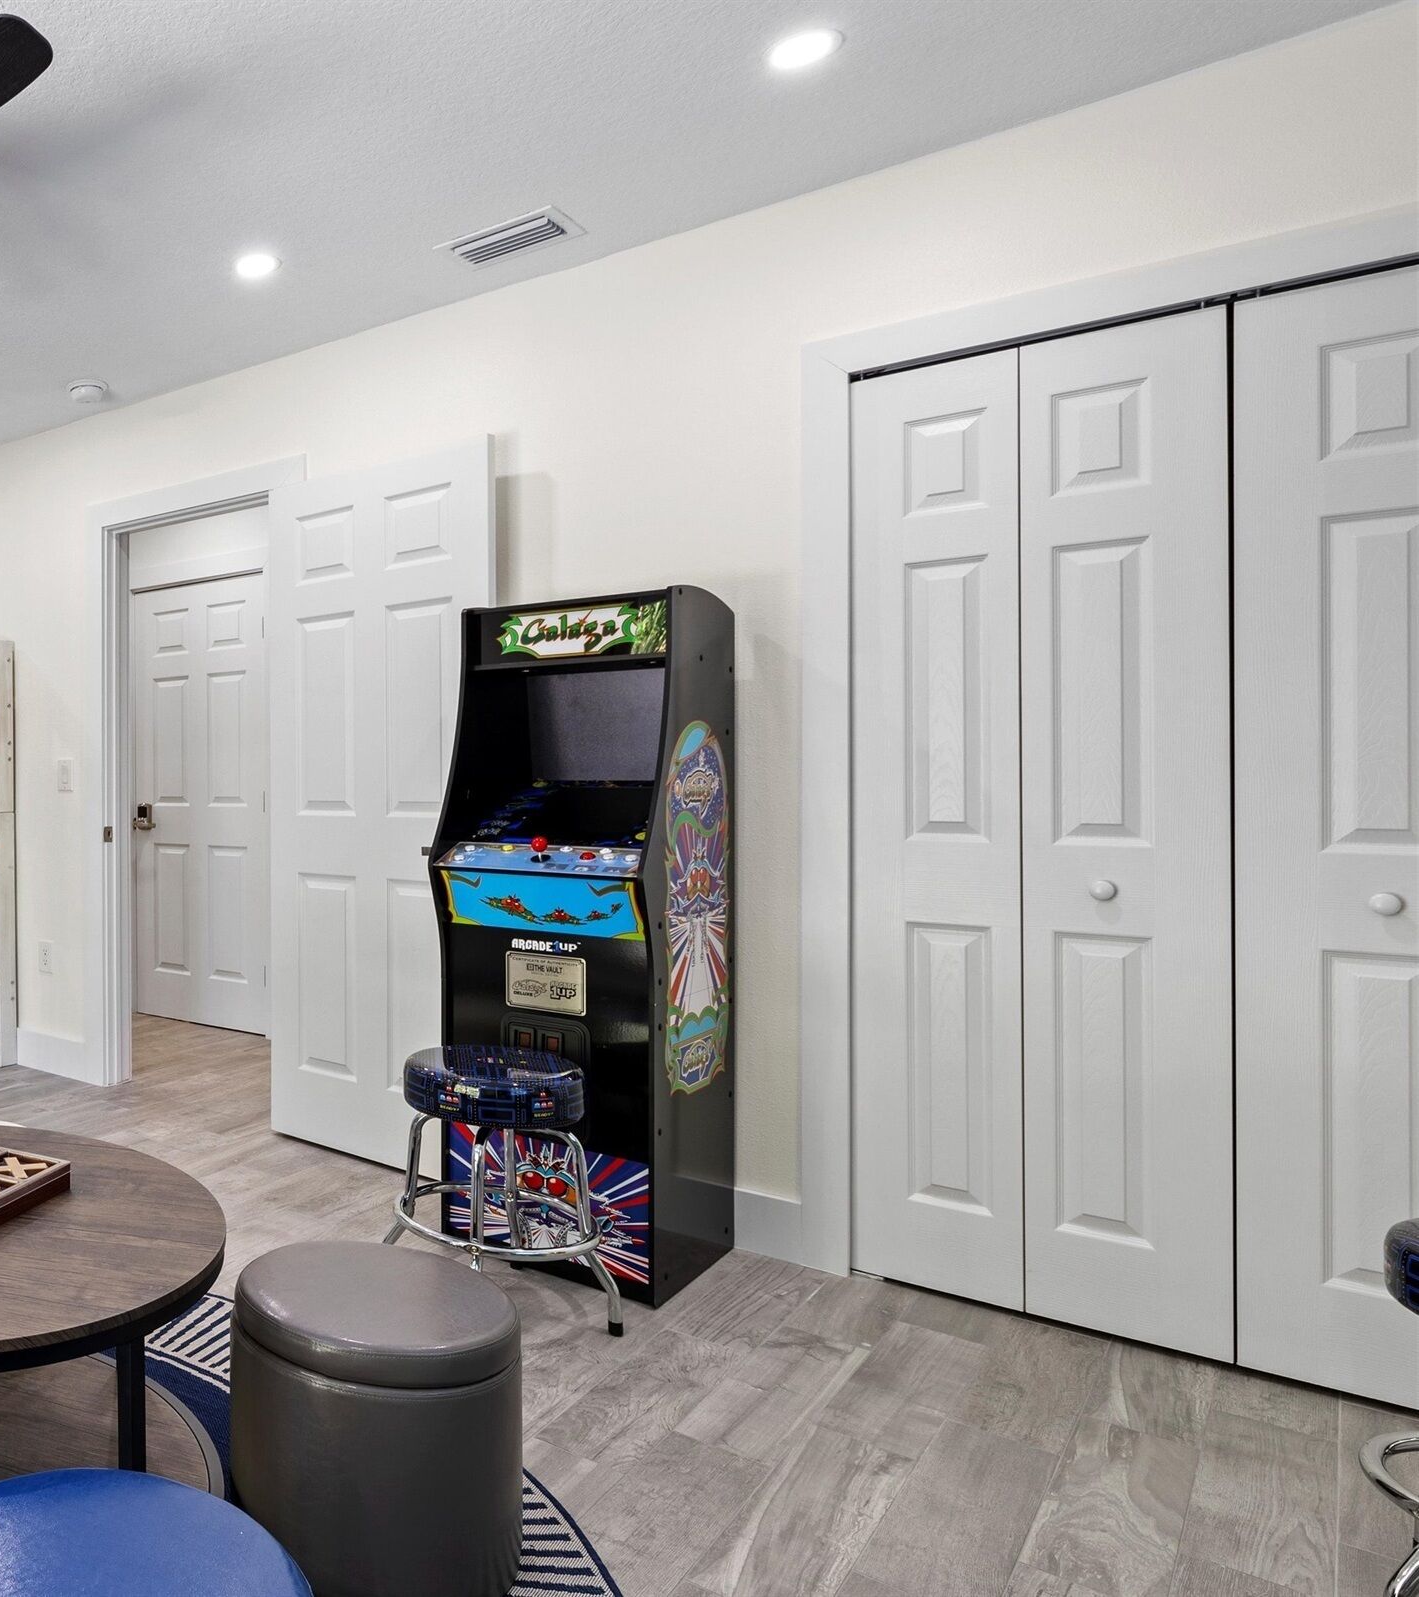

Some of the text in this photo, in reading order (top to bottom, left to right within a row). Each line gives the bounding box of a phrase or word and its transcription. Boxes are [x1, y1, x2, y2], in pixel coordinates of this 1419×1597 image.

[520, 613, 619, 653] Galaga
[534, 964, 563, 974] THE VAULT
